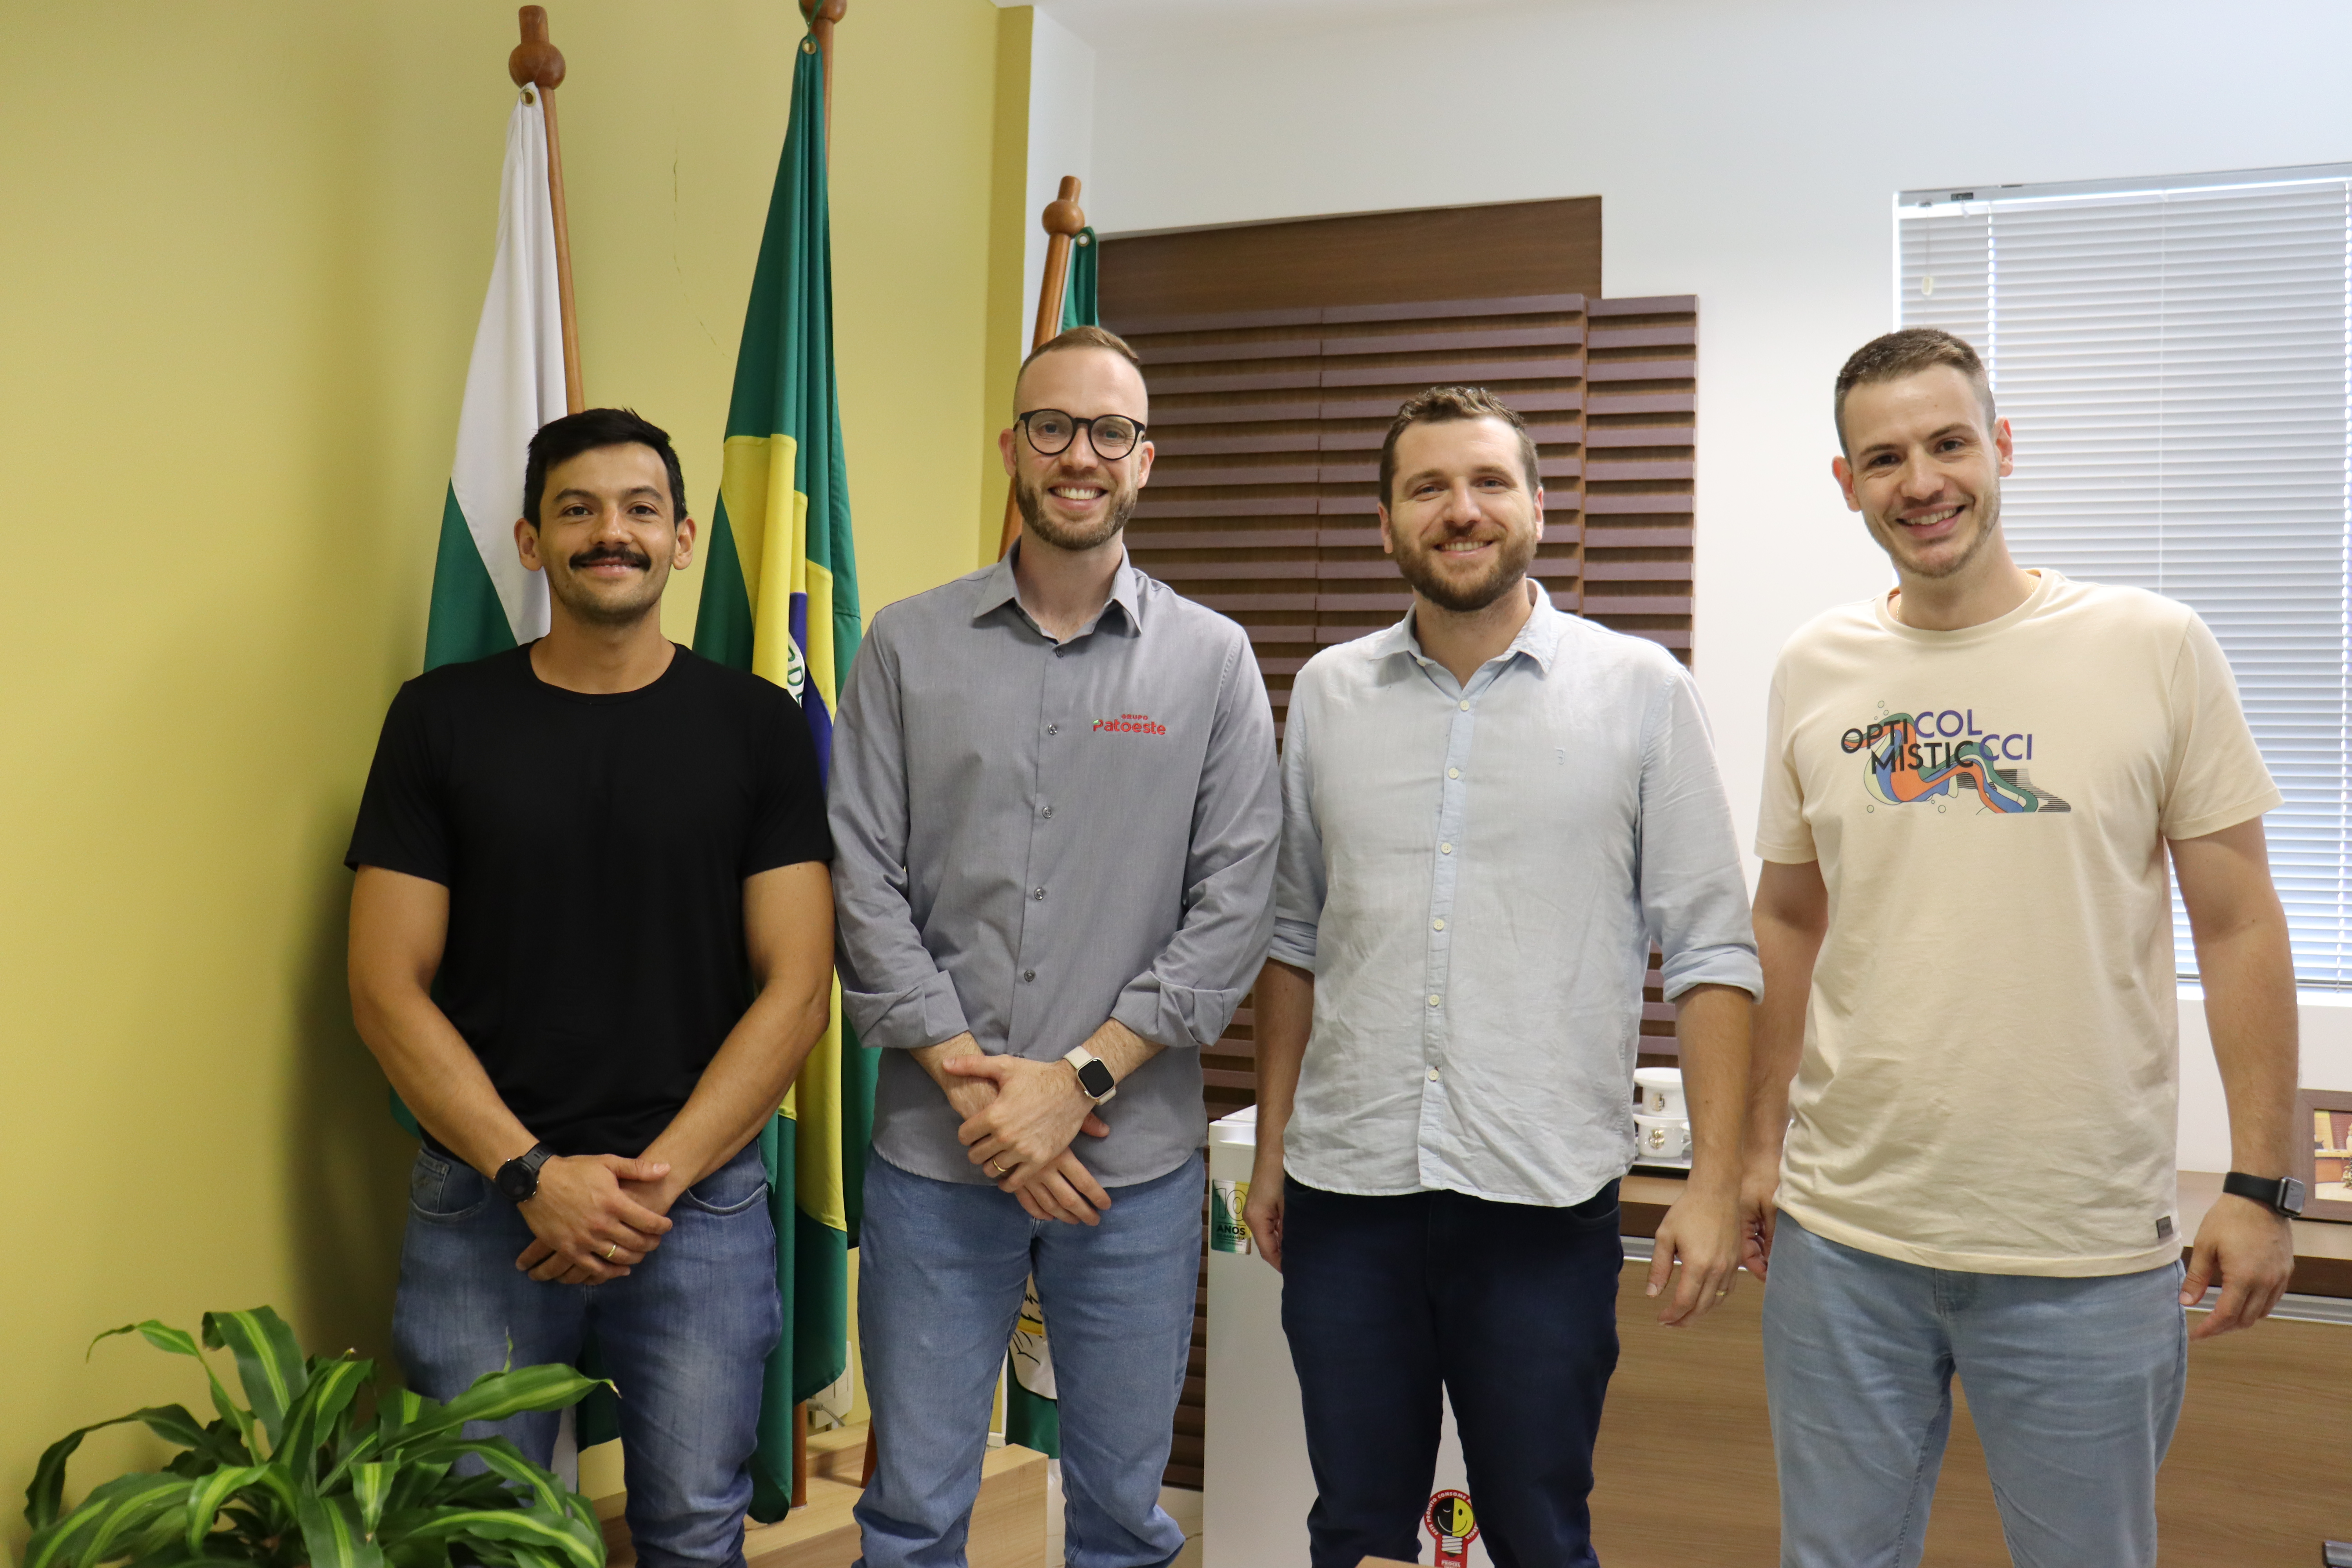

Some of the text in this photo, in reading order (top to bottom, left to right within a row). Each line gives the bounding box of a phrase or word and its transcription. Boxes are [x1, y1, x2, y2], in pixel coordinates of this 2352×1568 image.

[1093, 719, 1166, 735] Patoeste
[1215, 1188, 1246, 1221] 10
[1216, 1224, 1246, 1236] ANOS
[1437, 1492, 1466, 1500] CONSOME
[1426, 1498, 1437, 1523] PRODUTO
[1428, 1524, 1439, 1535] ESTE
